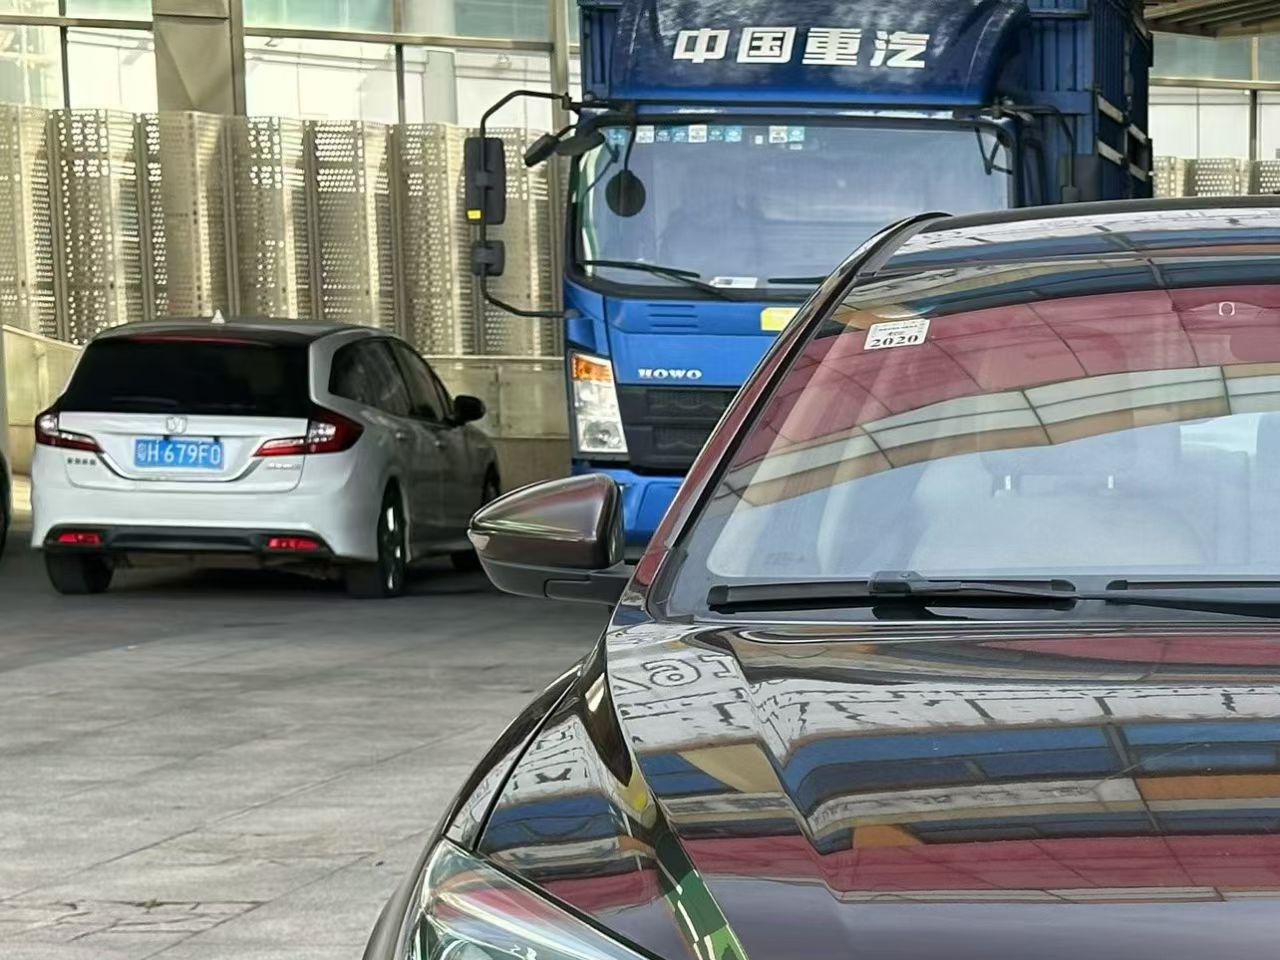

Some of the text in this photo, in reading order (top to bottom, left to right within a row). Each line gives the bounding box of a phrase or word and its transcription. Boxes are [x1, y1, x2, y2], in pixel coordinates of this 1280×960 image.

[673, 27, 930, 68] 中国重汽
[870, 334, 919, 348] 2020
